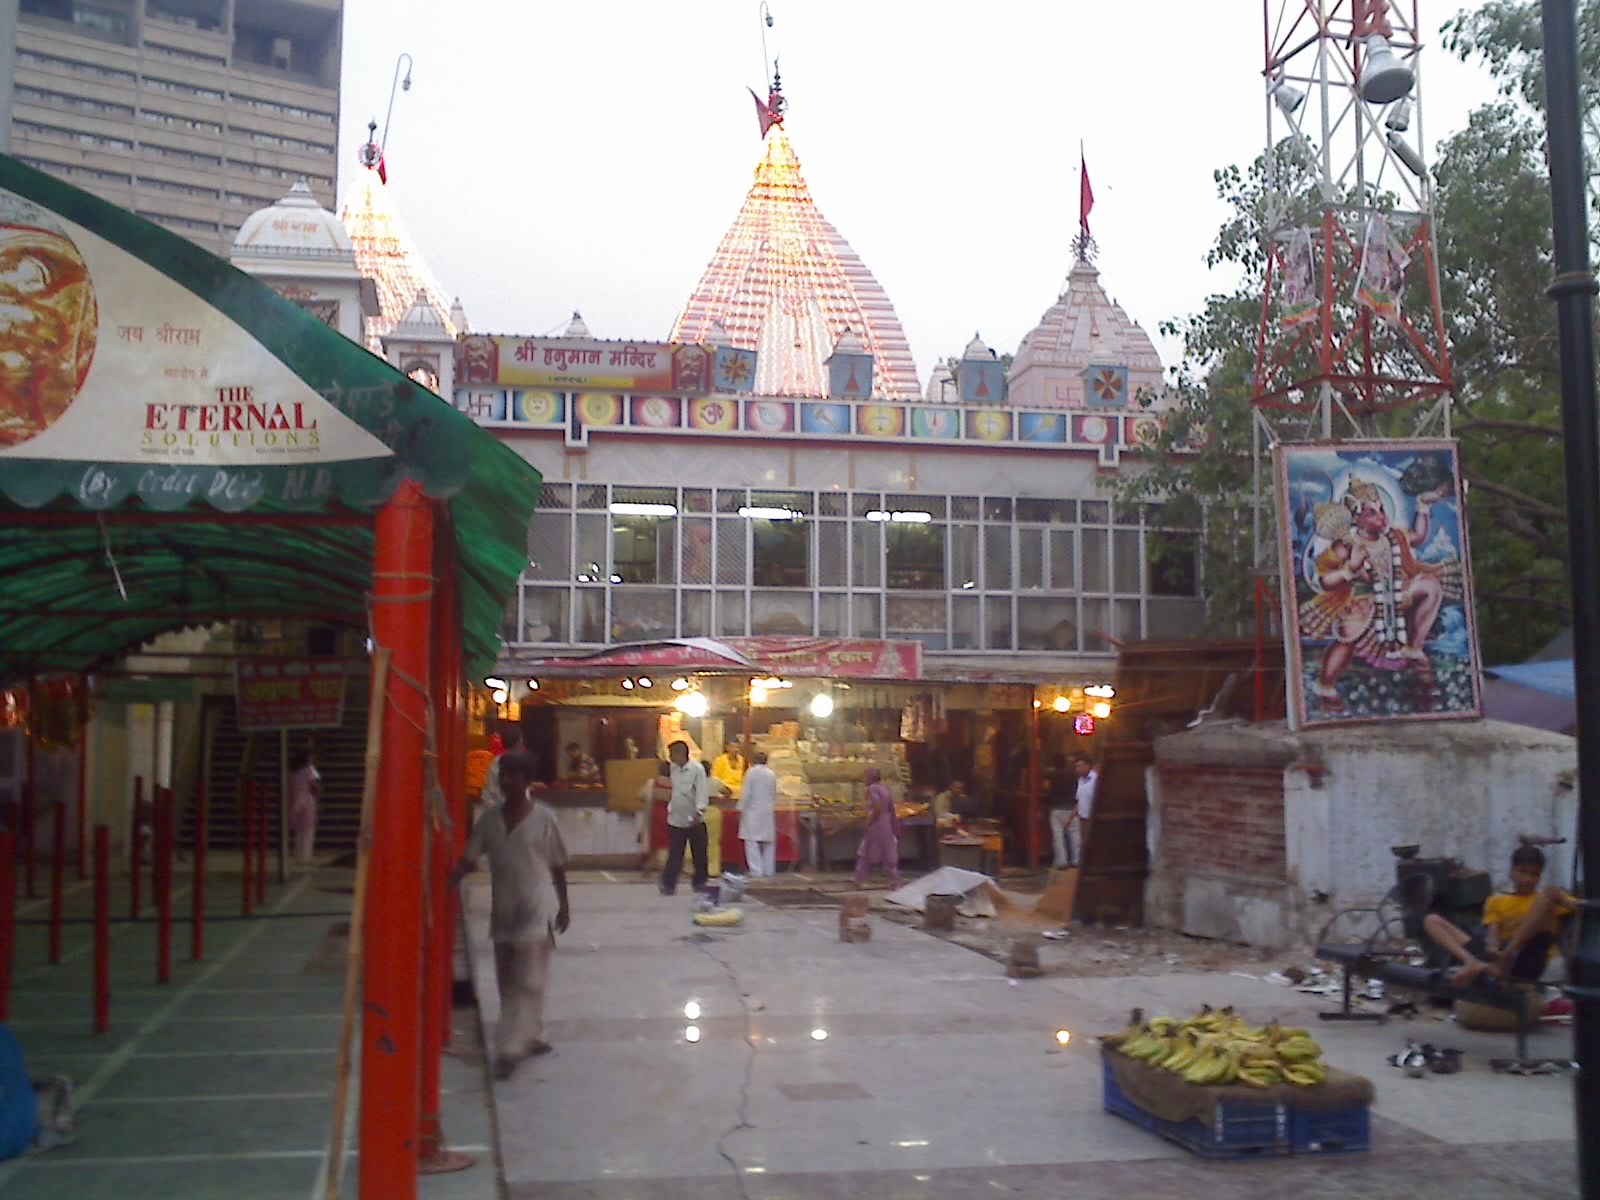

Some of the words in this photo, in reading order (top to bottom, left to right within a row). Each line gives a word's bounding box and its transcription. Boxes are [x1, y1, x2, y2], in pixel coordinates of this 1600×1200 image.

[117, 325, 144, 343] जय
[156, 322, 201, 345] श्रीराम
[515, 340, 536, 362] श्री
[543, 347, 602, 371] हनुमान
[609, 346, 657, 368] मन्दिर
[216, 386, 254, 402] THE
[145, 402, 317, 431] ETERNAL
[142, 431, 320, 447] SOLUTIONS
